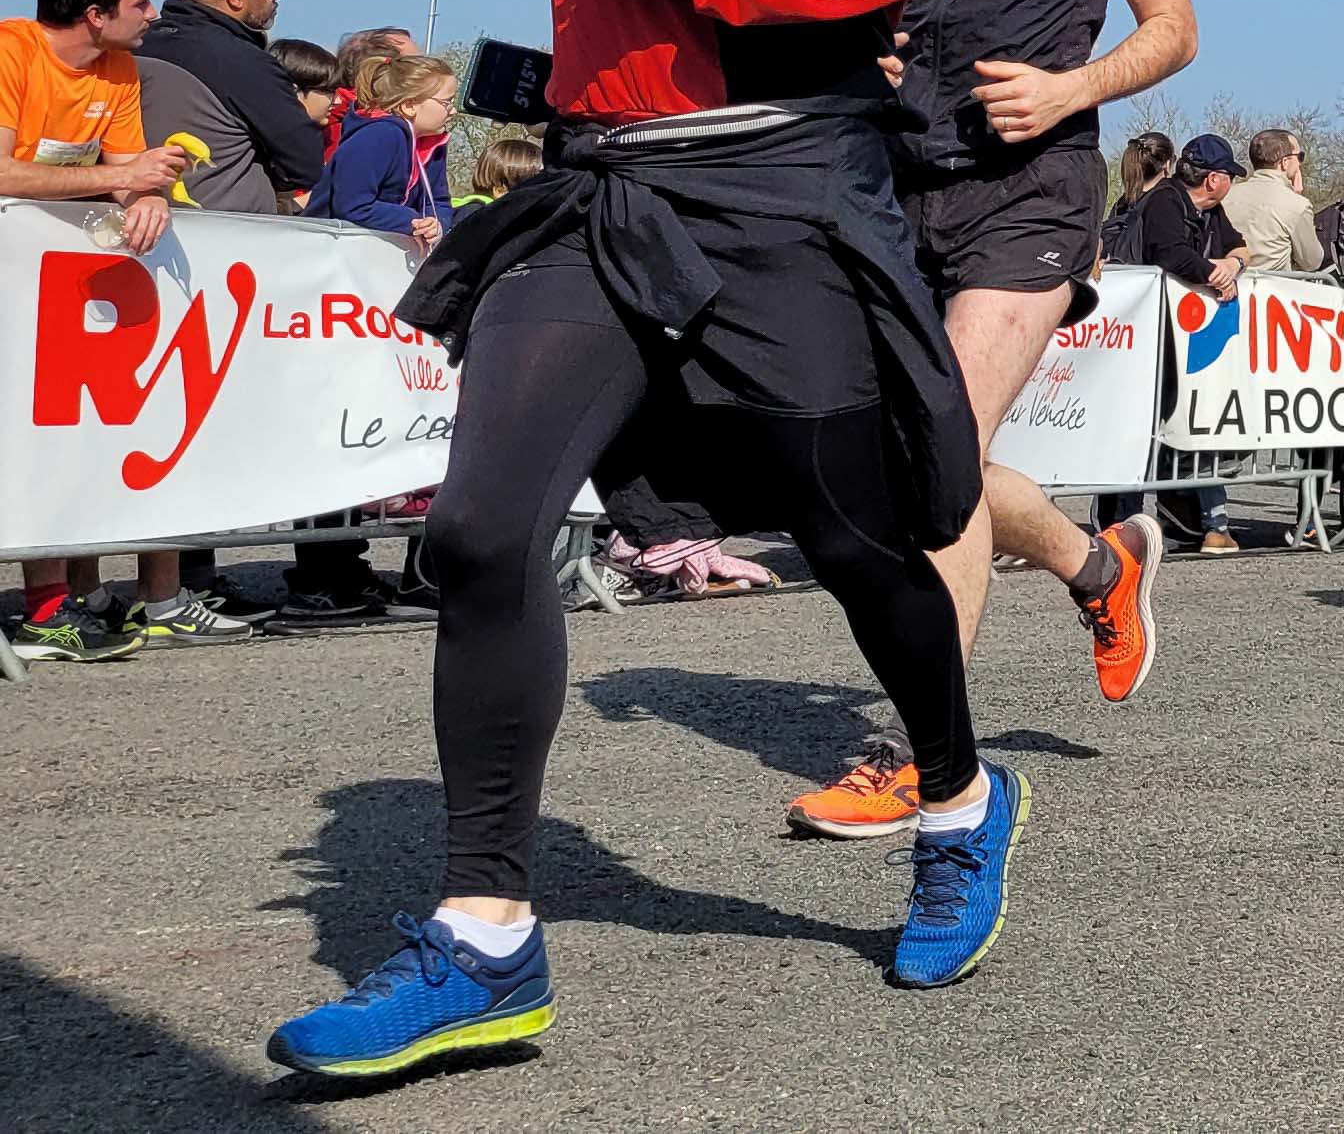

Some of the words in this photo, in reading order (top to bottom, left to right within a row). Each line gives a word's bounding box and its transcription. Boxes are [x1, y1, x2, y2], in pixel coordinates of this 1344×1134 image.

[264, 303, 311, 339] La
[396, 353, 448, 391] Ville
[340, 408, 387, 448] Le
[1188, 388, 1247, 436] LA
